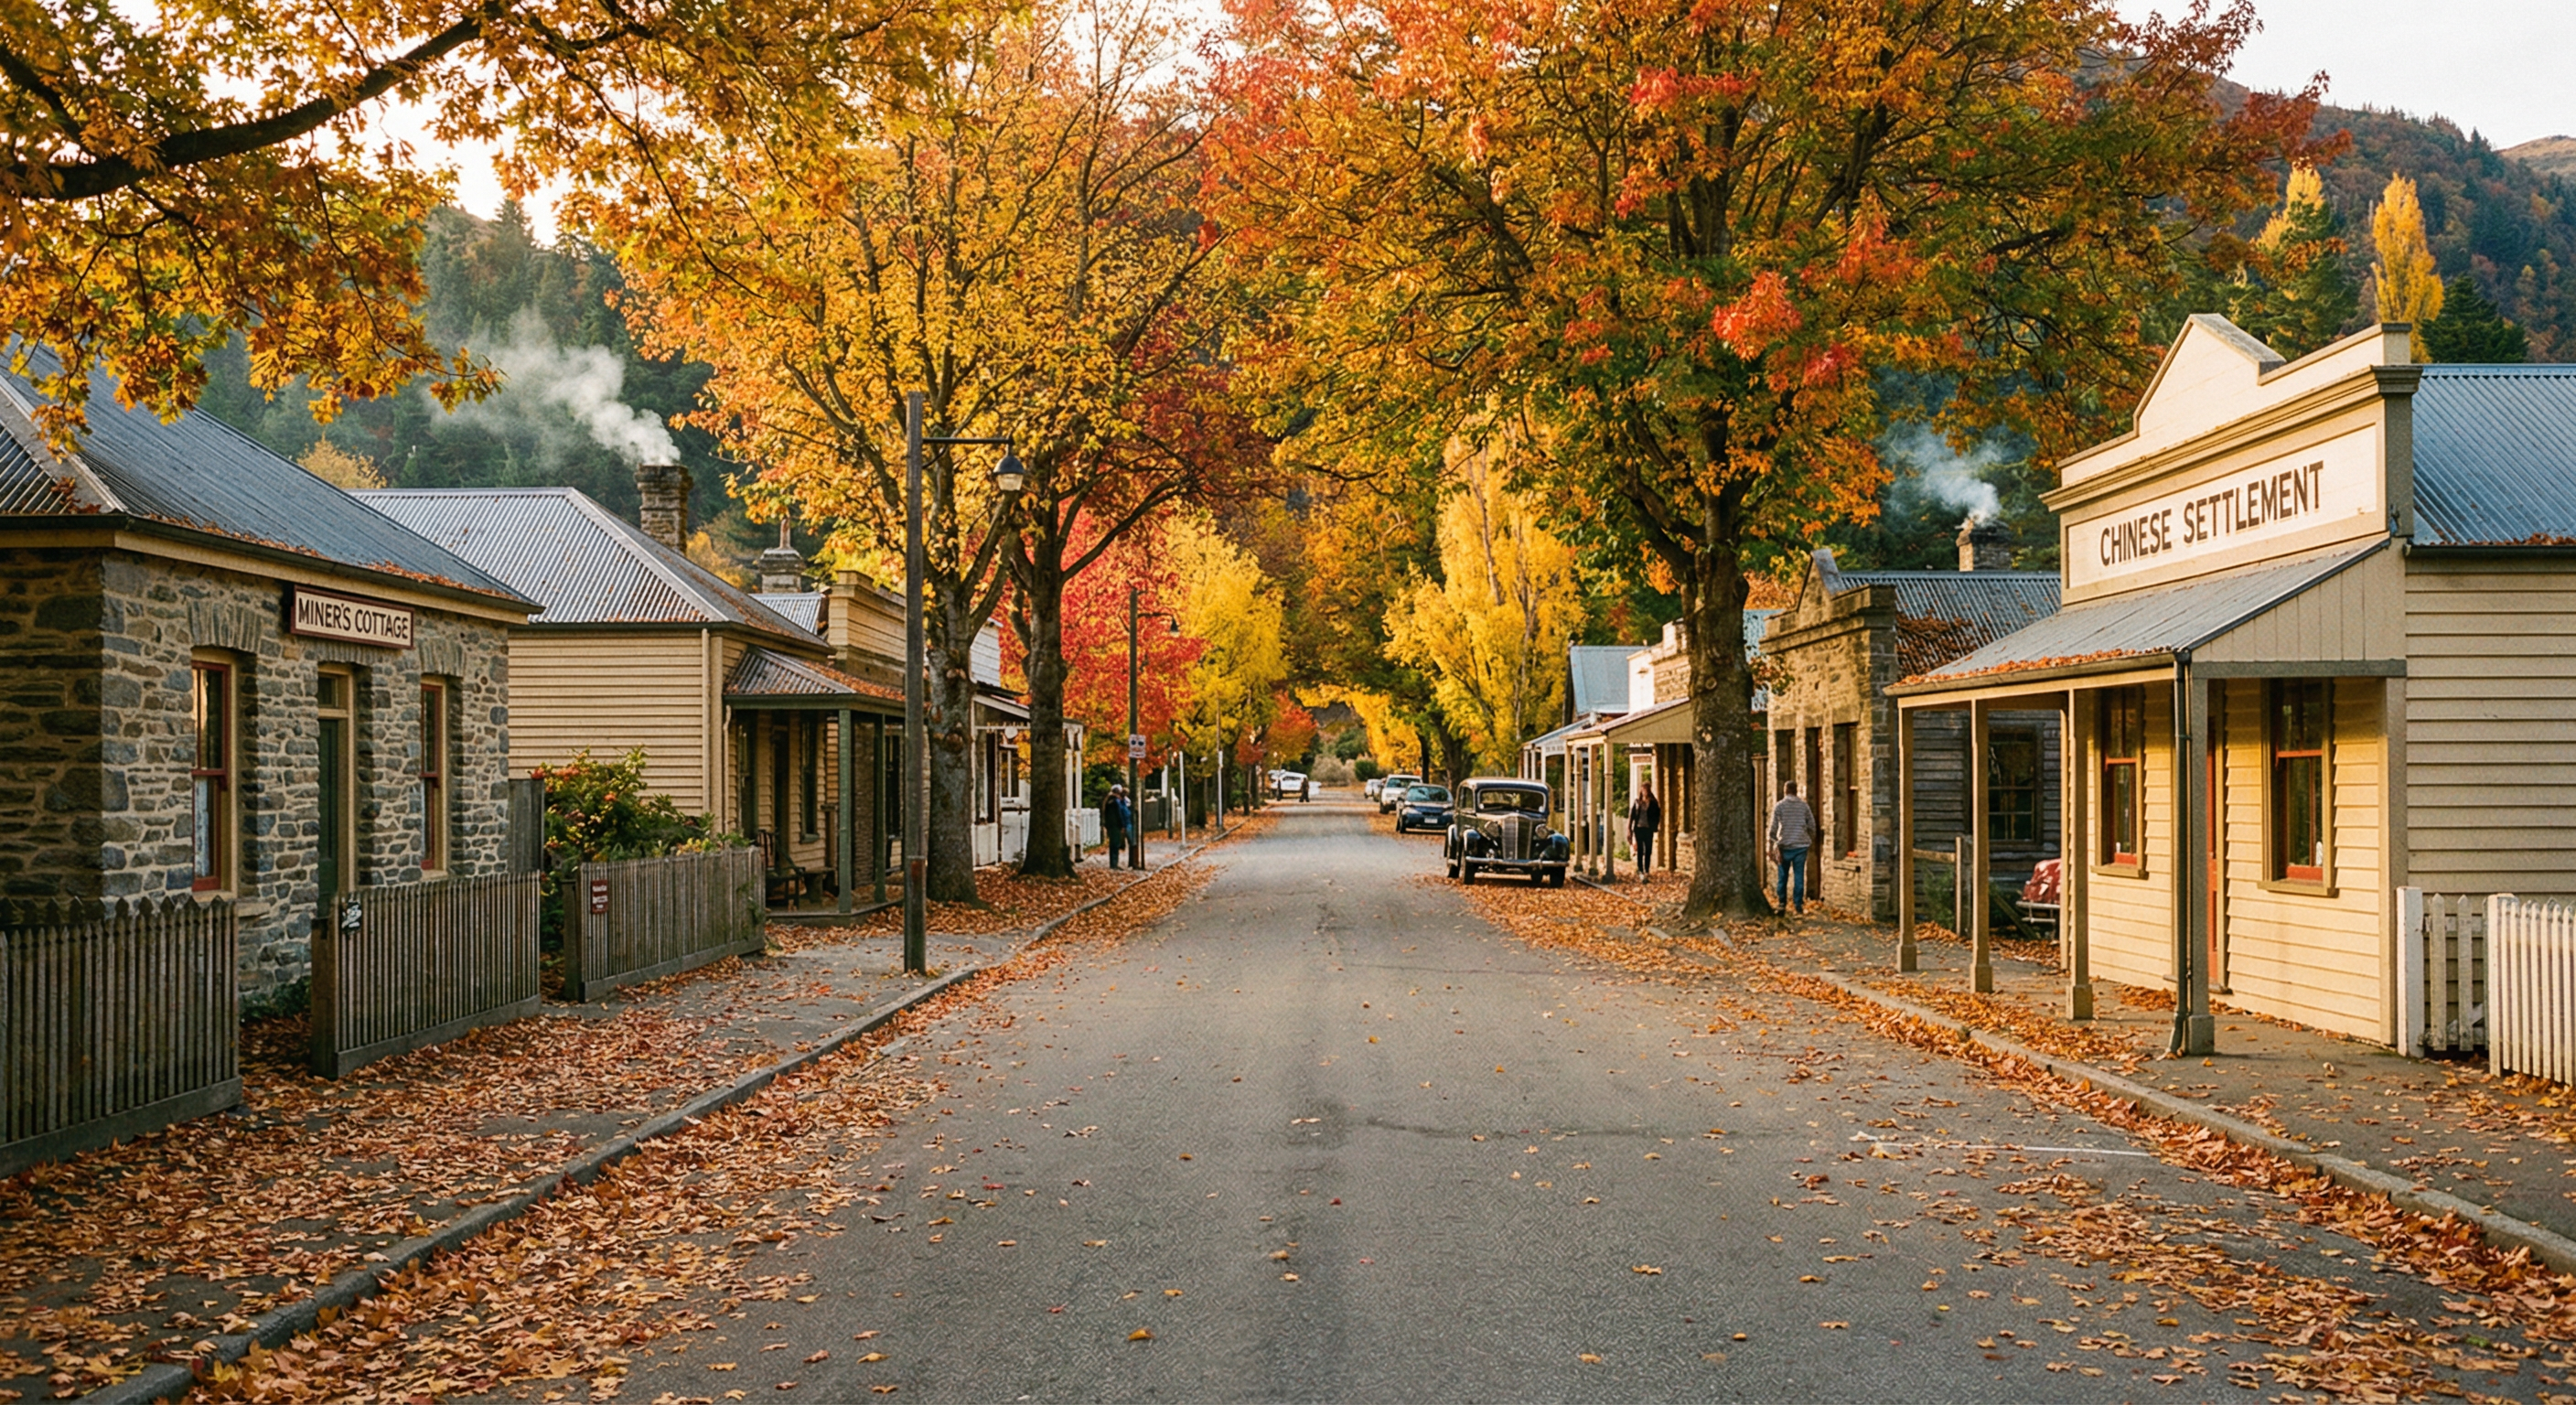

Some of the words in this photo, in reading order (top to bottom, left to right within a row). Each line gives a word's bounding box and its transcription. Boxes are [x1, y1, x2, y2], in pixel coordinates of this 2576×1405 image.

[2100, 509, 2173, 567] CHINESE
[2184, 460, 2324, 544] SETTLEMENT
[298, 597, 351, 631] MINER'S
[355, 609, 408, 639] COTTAGE
